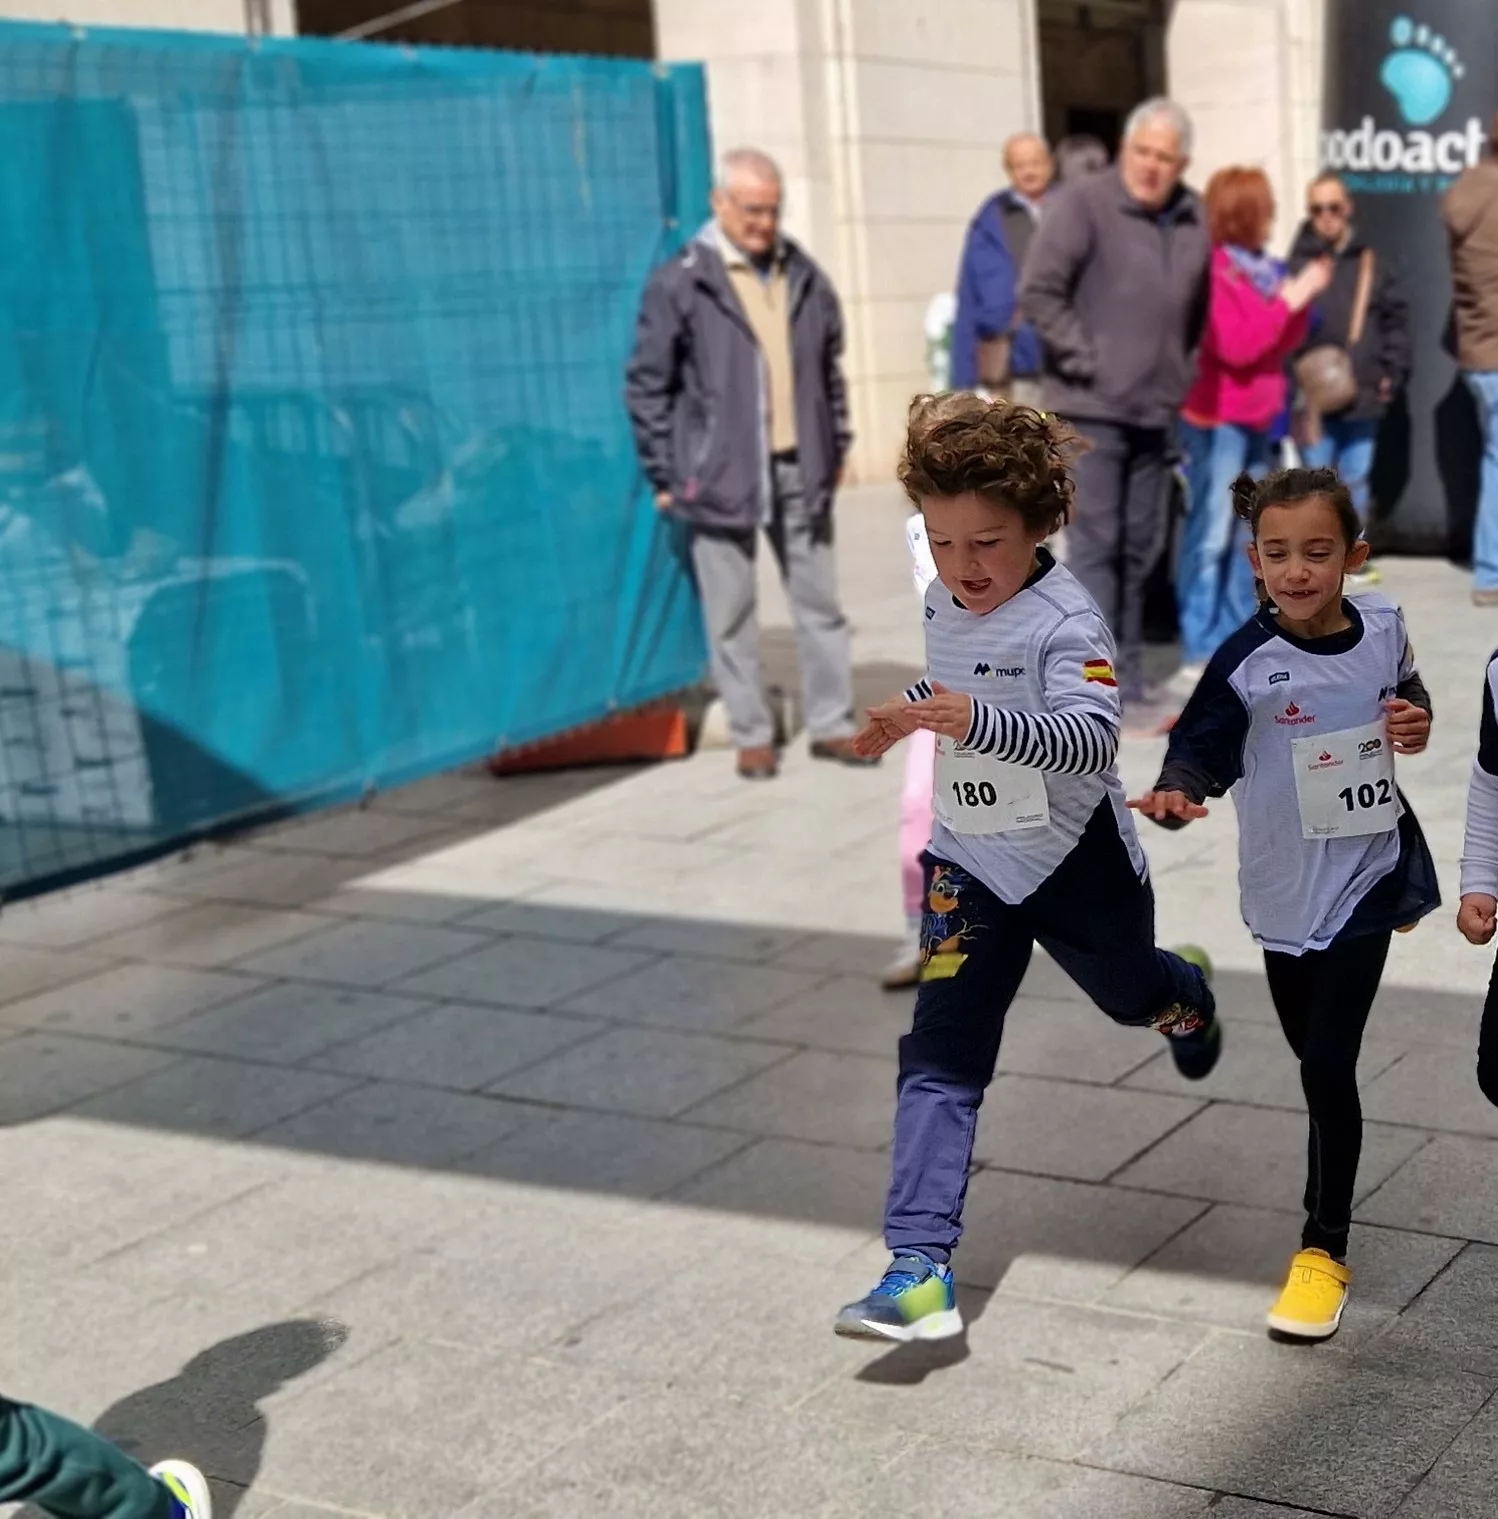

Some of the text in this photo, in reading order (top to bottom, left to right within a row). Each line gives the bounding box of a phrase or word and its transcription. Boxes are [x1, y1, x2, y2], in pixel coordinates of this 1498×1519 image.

[1274, 714, 1317, 725] Santander
[952, 780, 997, 807] 180
[1338, 778, 1393, 812] 102
